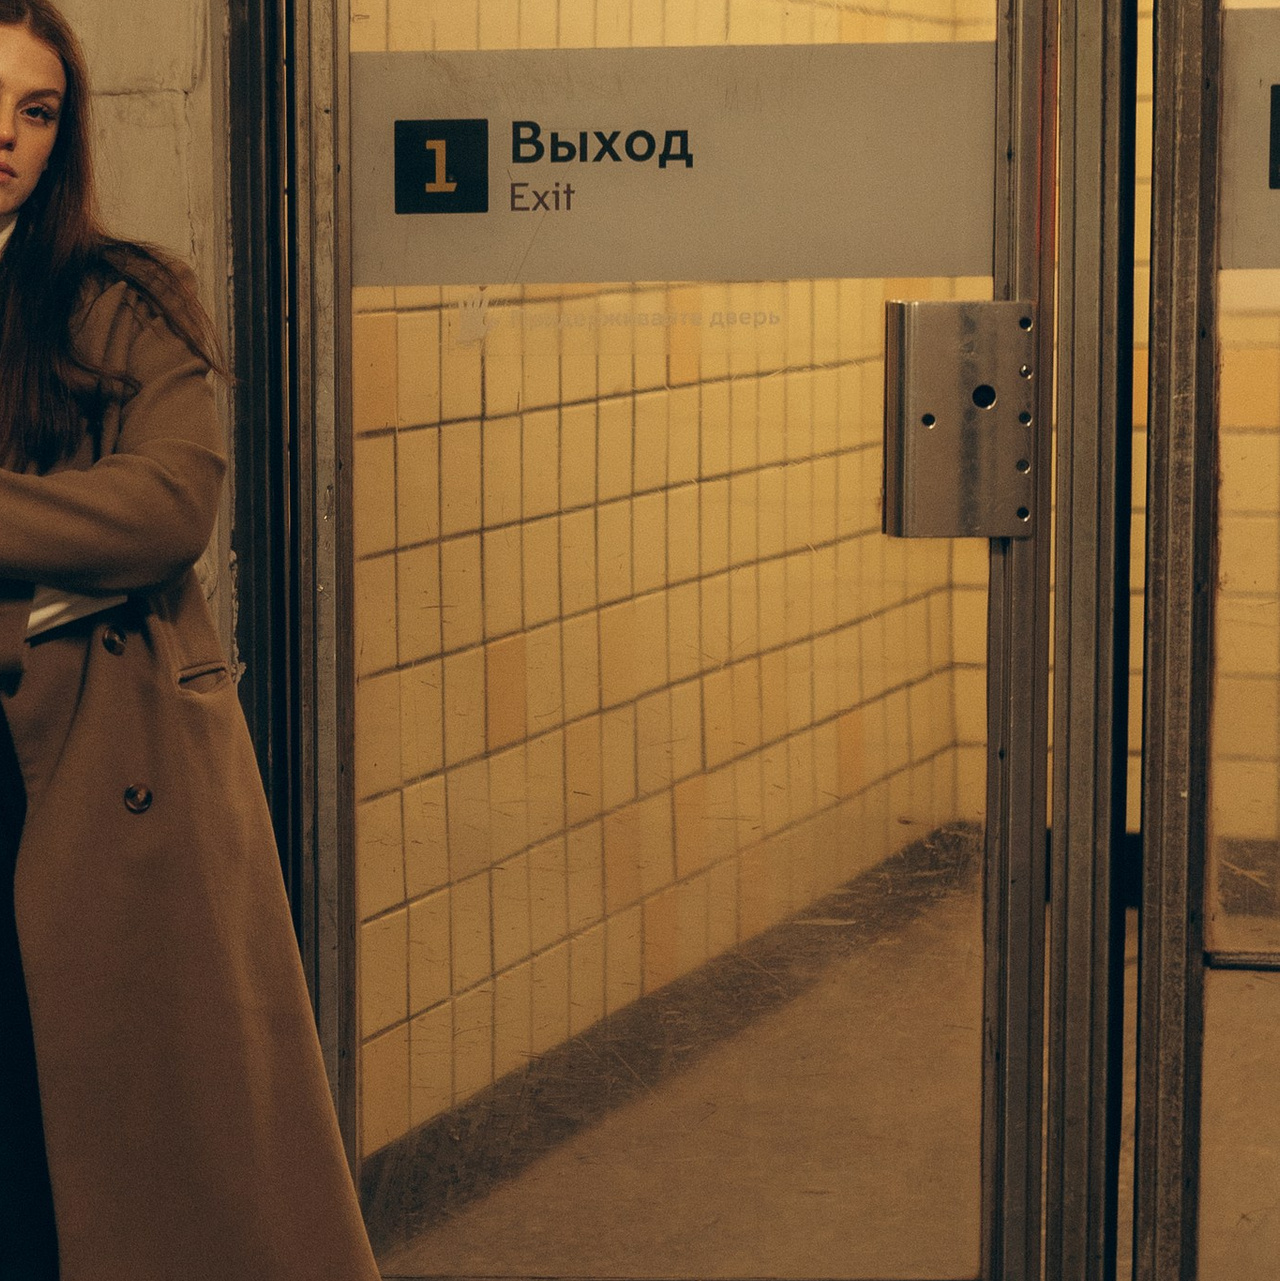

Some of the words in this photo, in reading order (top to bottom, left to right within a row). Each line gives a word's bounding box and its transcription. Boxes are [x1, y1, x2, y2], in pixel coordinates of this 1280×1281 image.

[511, 121, 694, 169] Выход
[425, 139, 458, 194] 1
[510, 182, 575, 211] Exit
[709, 308, 782, 329] дверь
